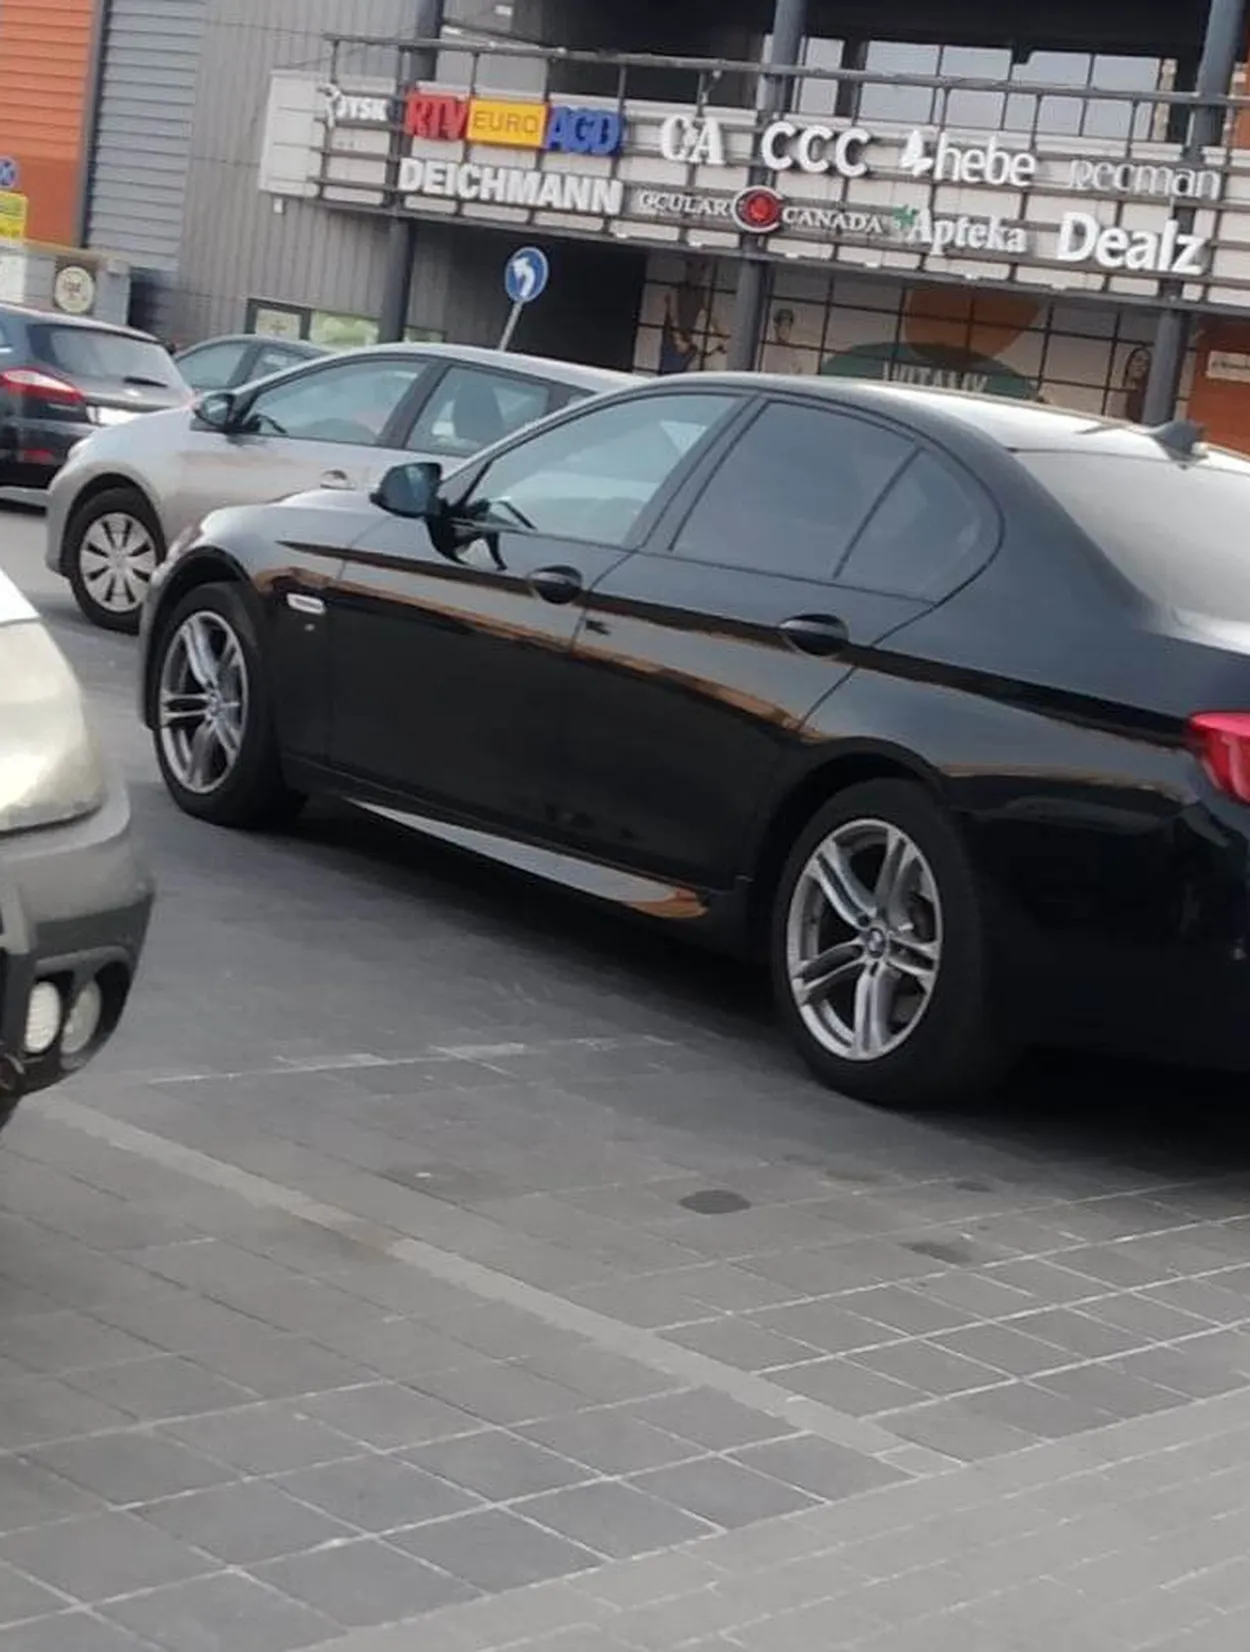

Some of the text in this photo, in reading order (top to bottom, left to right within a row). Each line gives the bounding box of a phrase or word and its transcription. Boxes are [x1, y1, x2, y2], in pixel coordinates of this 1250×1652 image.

[473, 110, 540, 135] EURO
[761, 121, 870, 178] CCC
[399, 157, 624, 216] DEICHMANN
[933, 132, 1037, 187] hebe
[782, 206, 883, 234] CANADA
[906, 208, 1027, 256] Apteka
[1056, 211, 1207, 275] Dealz
